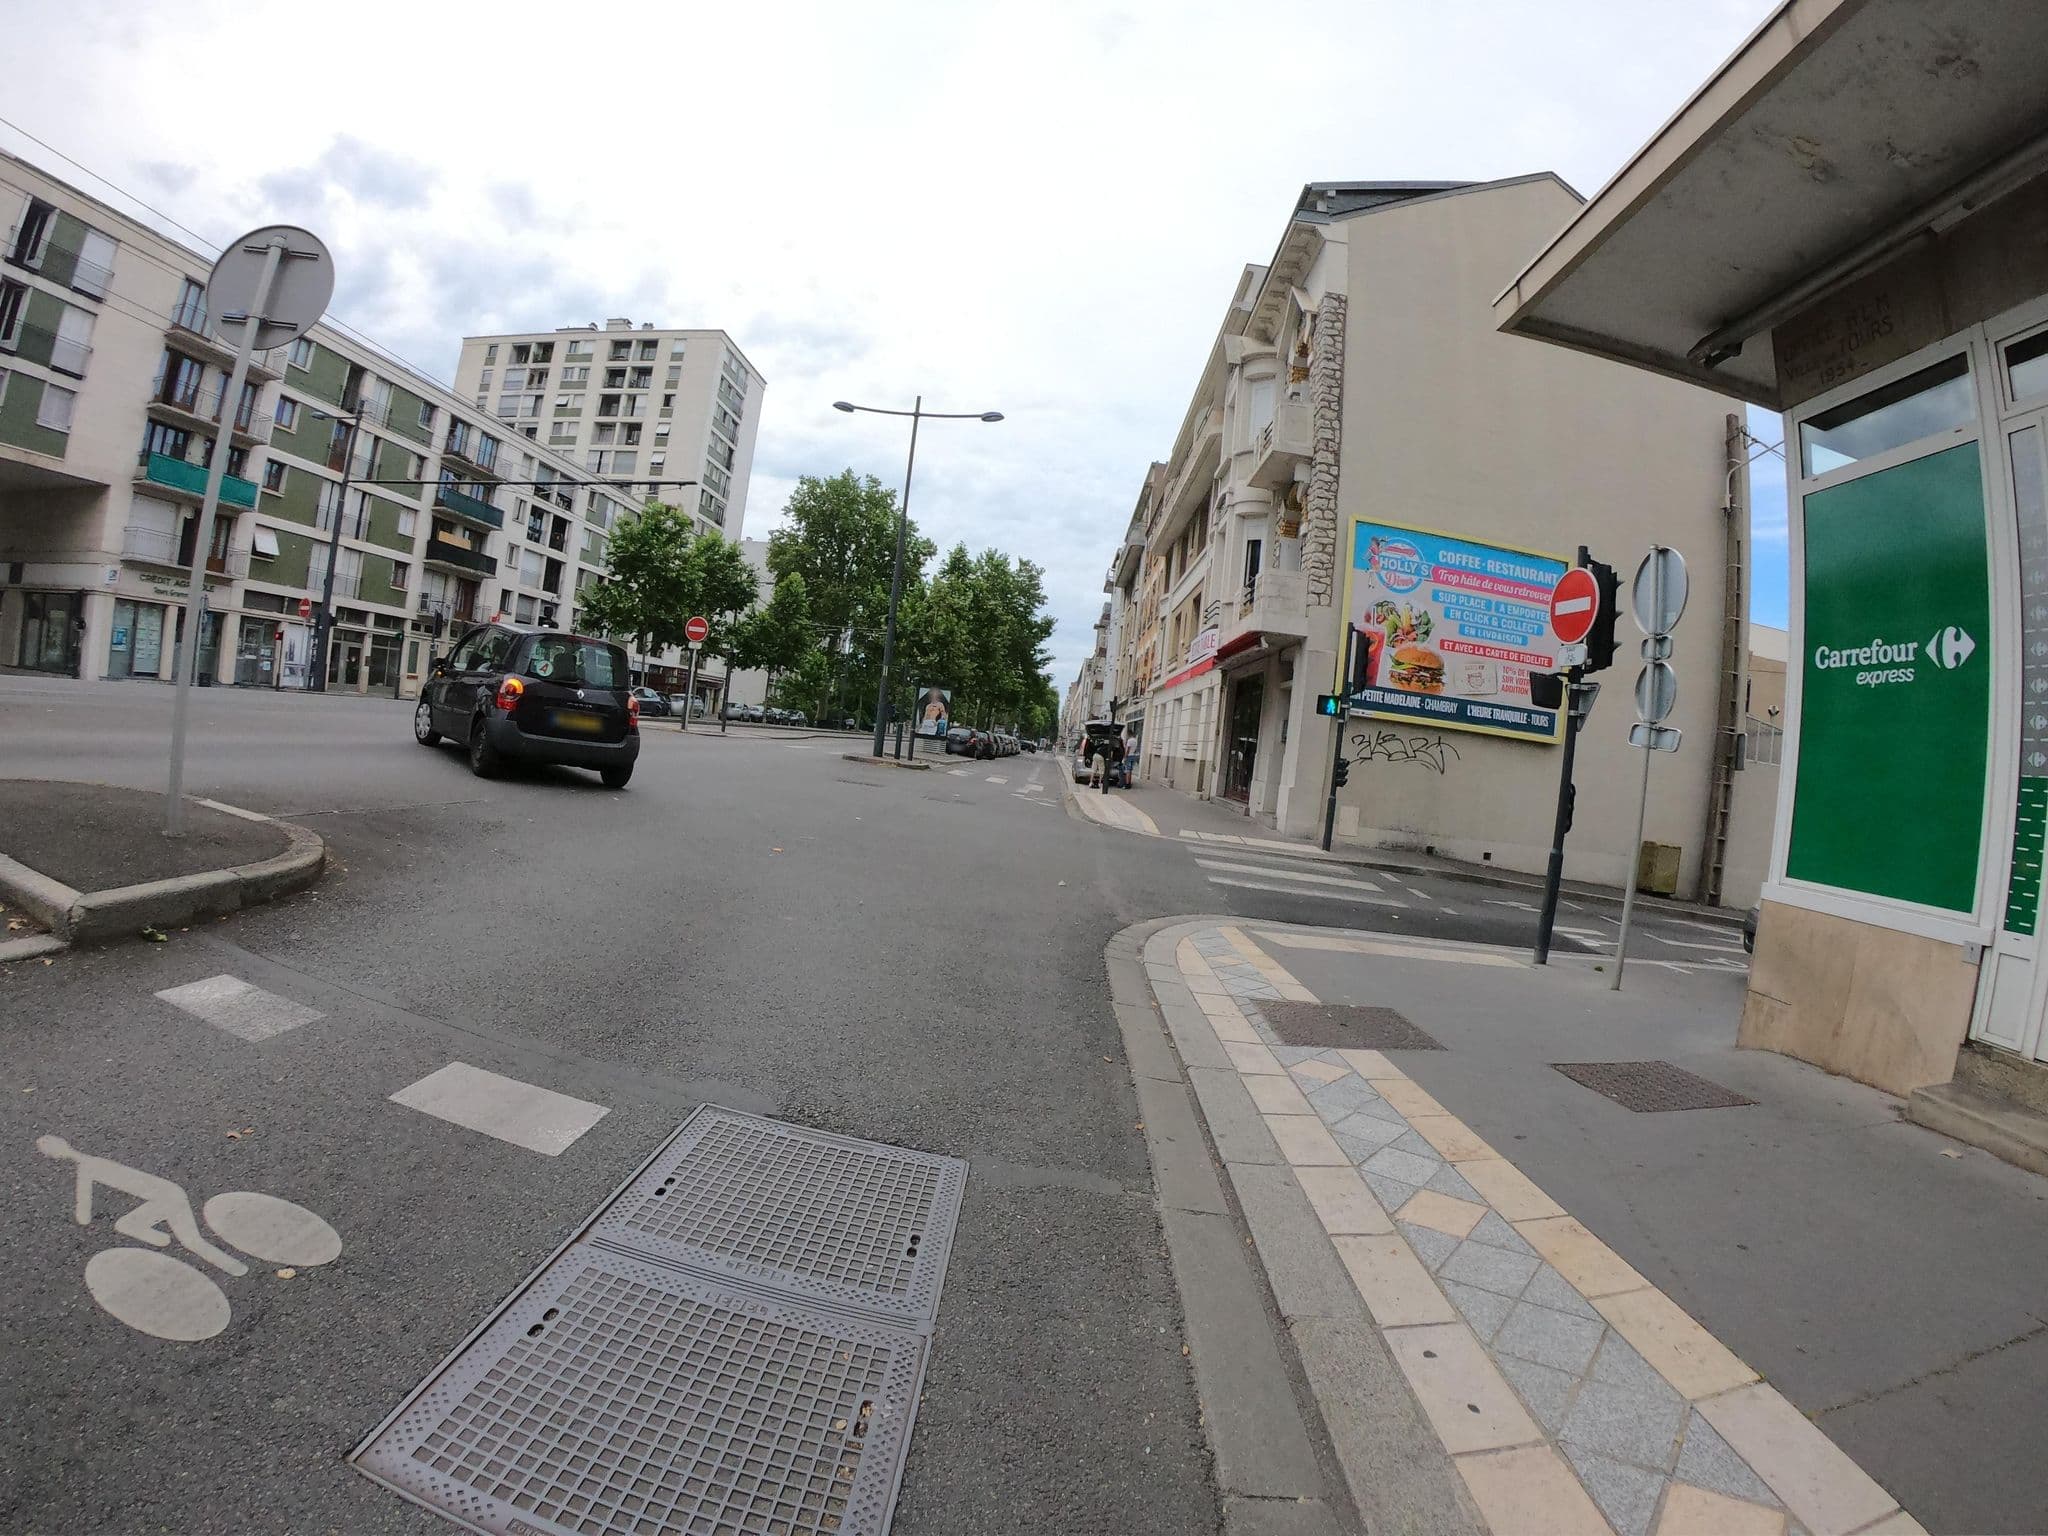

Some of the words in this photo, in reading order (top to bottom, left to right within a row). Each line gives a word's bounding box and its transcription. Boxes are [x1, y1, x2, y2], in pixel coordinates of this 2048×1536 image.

[1439, 551, 1480, 569] COFFEE
[1487, 559, 1559, 585] RESTAURANT
[1438, 569, 1460, 585] Trop
[1460, 575, 1482, 587] hâte
[1482, 580, 1493, 590] de
[1494, 583, 1514, 594] vous
[1438, 592, 1457, 603] SUR
[1459, 595, 1487, 610] PLACE
[1450, 609, 1461, 619] EN
[1463, 611, 1489, 625] CLICK
[1491, 617, 1498, 626] &
[1501, 619, 1538, 634] COLLECT
[1464, 626, 1478, 636] EN
[1478, 628, 1523, 644] LIVRAISON
[1444, 641, 1453, 650] ET
[1455, 643, 1474, 653] AVEC
[1475, 646, 1484, 655] LA
[1486, 648, 1508, 659] CARTE
[1509, 652, 1519, 661] DE
[1520, 653, 1549, 666] FIDELITE
[1815, 638, 1918, 669] Carrefour
[1502, 685, 1529, 695] ADDITION
[1503, 675, 1514, 684] SUR
[1856, 668, 1915, 688] express
[1362, 689, 1383, 703] PETITE
[1425, 698, 1458, 714] CHAMBRAY
[1467, 704, 1492, 719] L'HEURE
[1492, 708, 1527, 724] TRANQUILLE
[1531, 714, 1549, 727] TOURS
